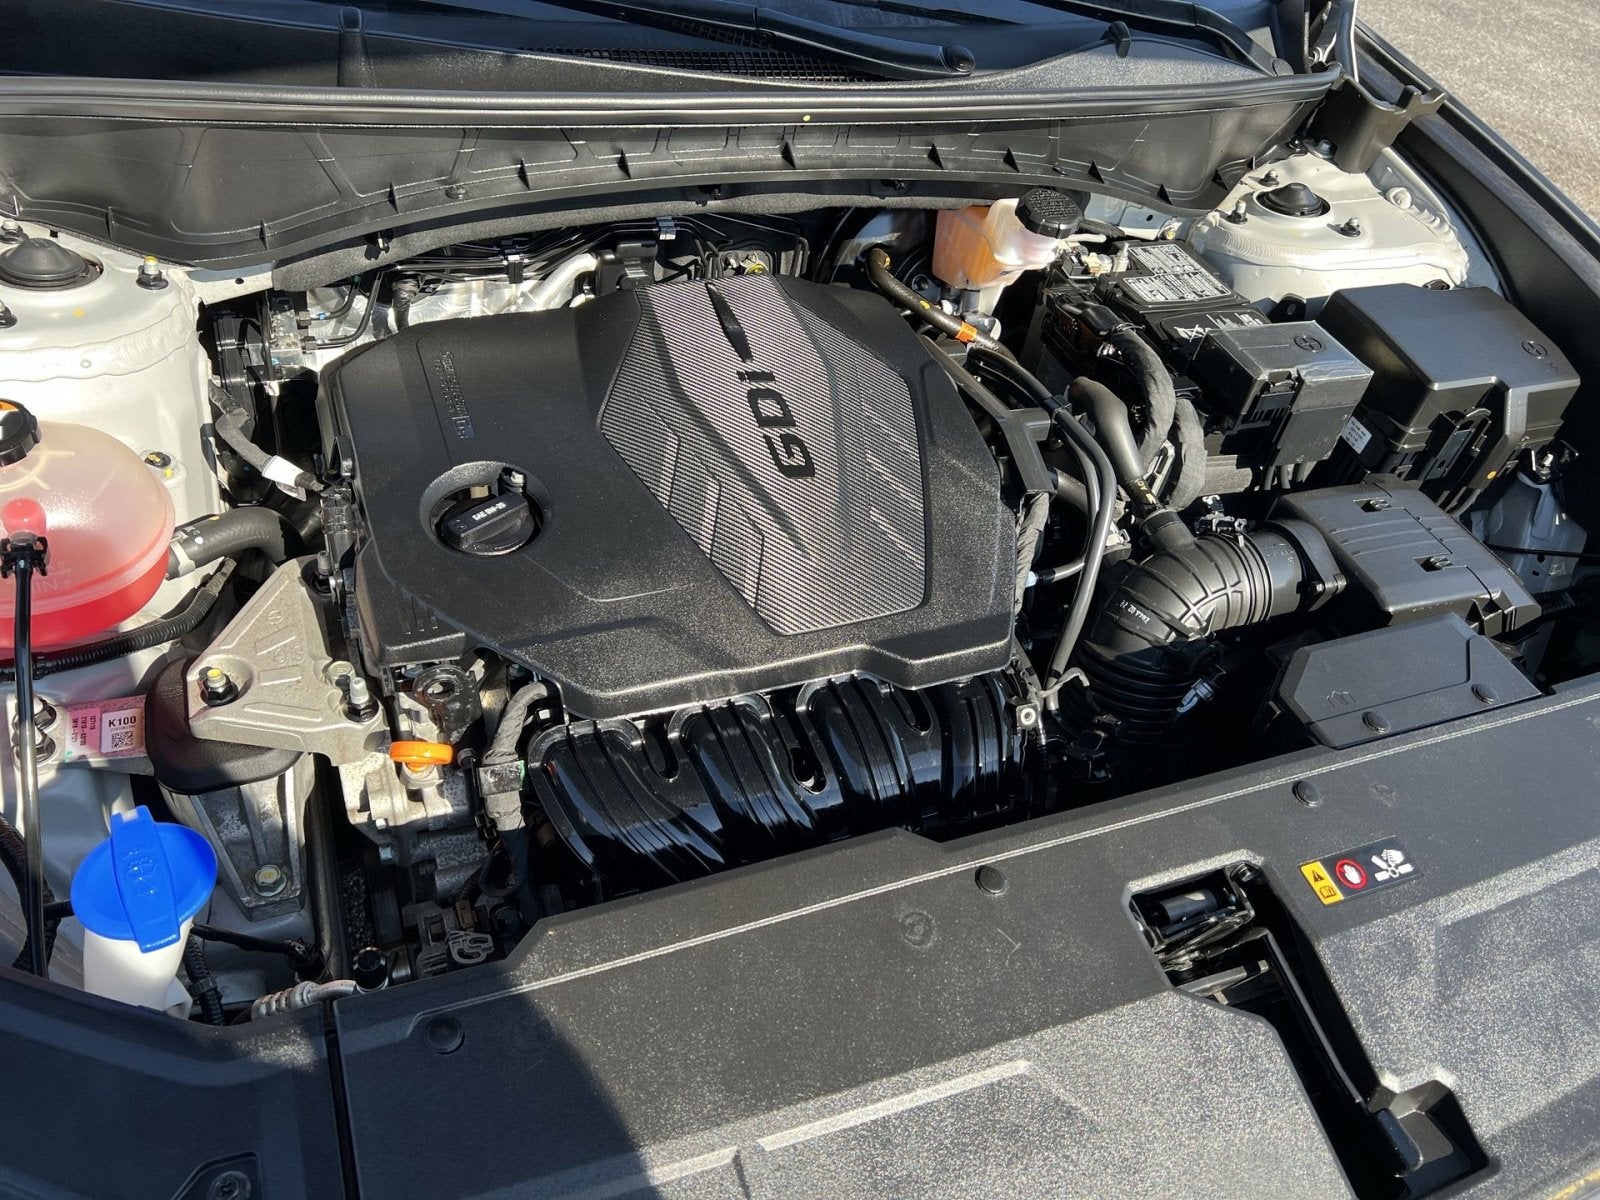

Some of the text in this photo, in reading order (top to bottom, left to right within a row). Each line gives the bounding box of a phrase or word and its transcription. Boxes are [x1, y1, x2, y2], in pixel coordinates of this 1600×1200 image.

[736, 371, 816, 479] GDi
[472, 511, 487, 521] SAE
[108, 715, 137, 727] K100
